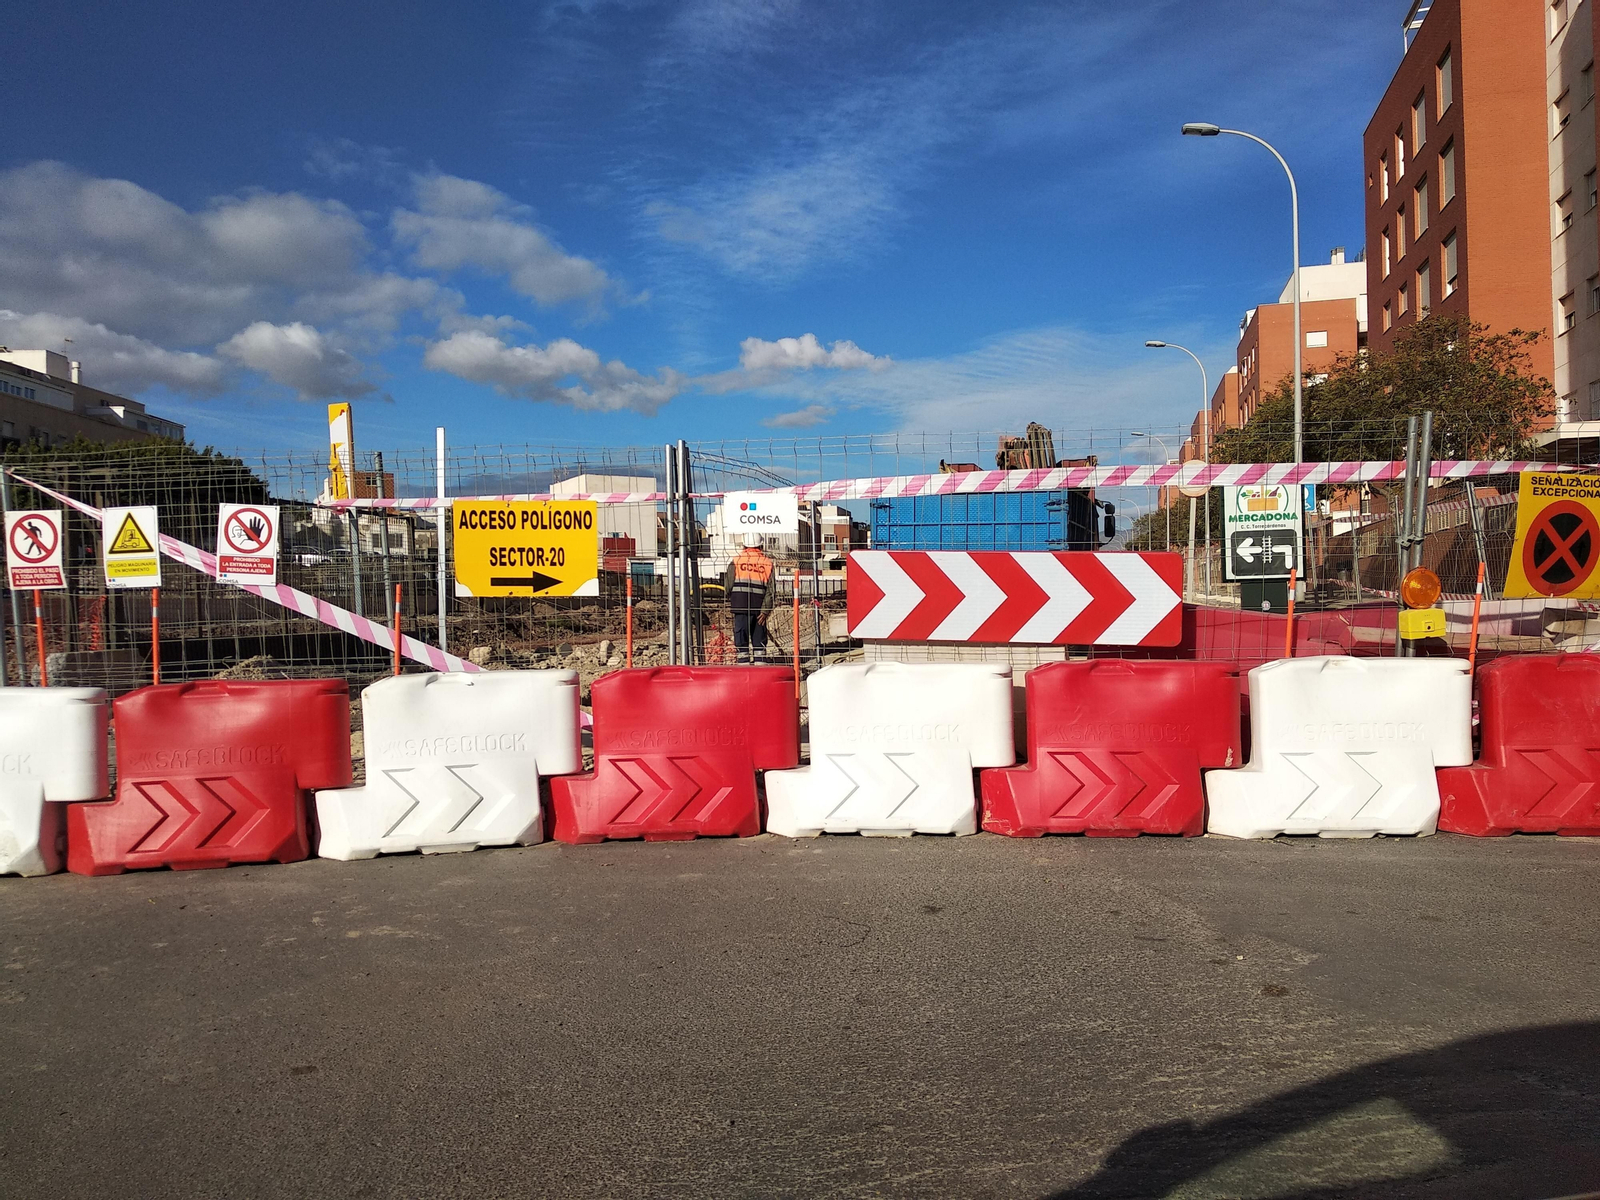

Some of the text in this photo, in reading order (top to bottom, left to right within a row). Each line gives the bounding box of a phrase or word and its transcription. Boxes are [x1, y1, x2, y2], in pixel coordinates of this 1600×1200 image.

[459, 505, 592, 530] ACCESO POLÍGONO
[739, 515, 781, 524] COMSA
[1228, 513, 1298, 522] MERCADONA
[489, 547, 565, 567] SECTOR-20
[404, 733, 527, 757] SAFEBLOCK
[629, 729, 747, 755] SAFEBLOCK
[156, 742, 287, 769] SAFEBLOCK
